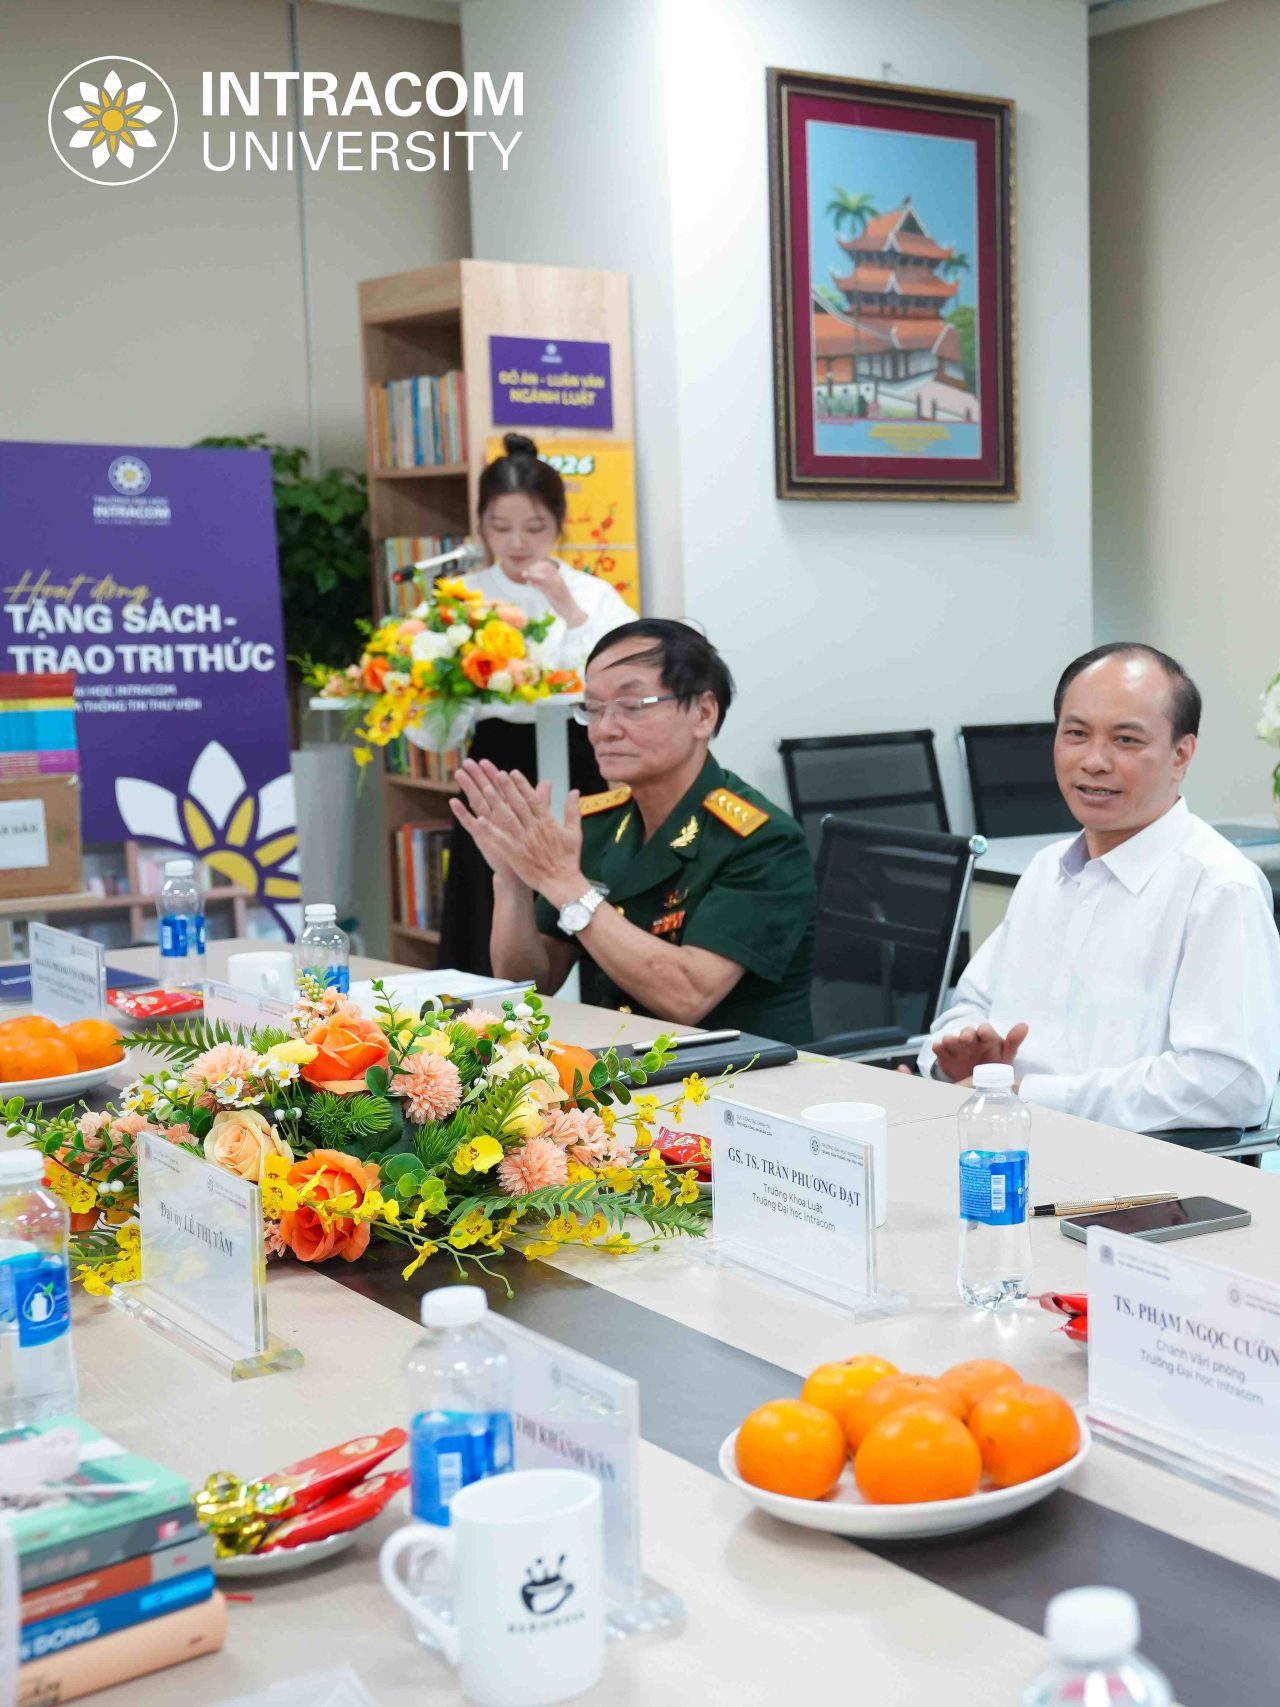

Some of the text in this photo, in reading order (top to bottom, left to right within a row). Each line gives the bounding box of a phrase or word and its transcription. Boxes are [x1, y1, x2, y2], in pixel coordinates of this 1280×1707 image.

[509, 388, 596, 408] NGÀNH LUẬT
[93, 504, 171, 520] INTRACOM
[4, 598, 114, 641] TẶNG
[8, 636, 276, 675] TRAO TRI THỨC
[728, 1147, 861, 1208] GS. TS. TRẦN PHƯƠNG ĐẠT
[777, 1201, 789, 1215] Đại
[789, 1208, 803, 1221] học
[803, 1212, 837, 1233] Intracom
[788, 1193, 807, 1207] Khoa
[807, 1199, 823, 1214] Luật
[160, 1200, 173, 1225] Đại
[184, 1213, 195, 1236] LÊ
[196, 1222, 212, 1249] THỊ
[212, 1231, 233, 1257] TÂM
[1113, 1294, 1135, 1317] TS.
[1138, 1303, 1182, 1333] PHẠM
[1185, 1319, 1231, 1350] NGỌC
[1155, 1338, 1189, 1361] Chánh
[1190, 1350, 1210, 1369] Văn
[1195, 1371, 1215, 1389] học
[1216, 1380, 1265, 1405] Intracom
